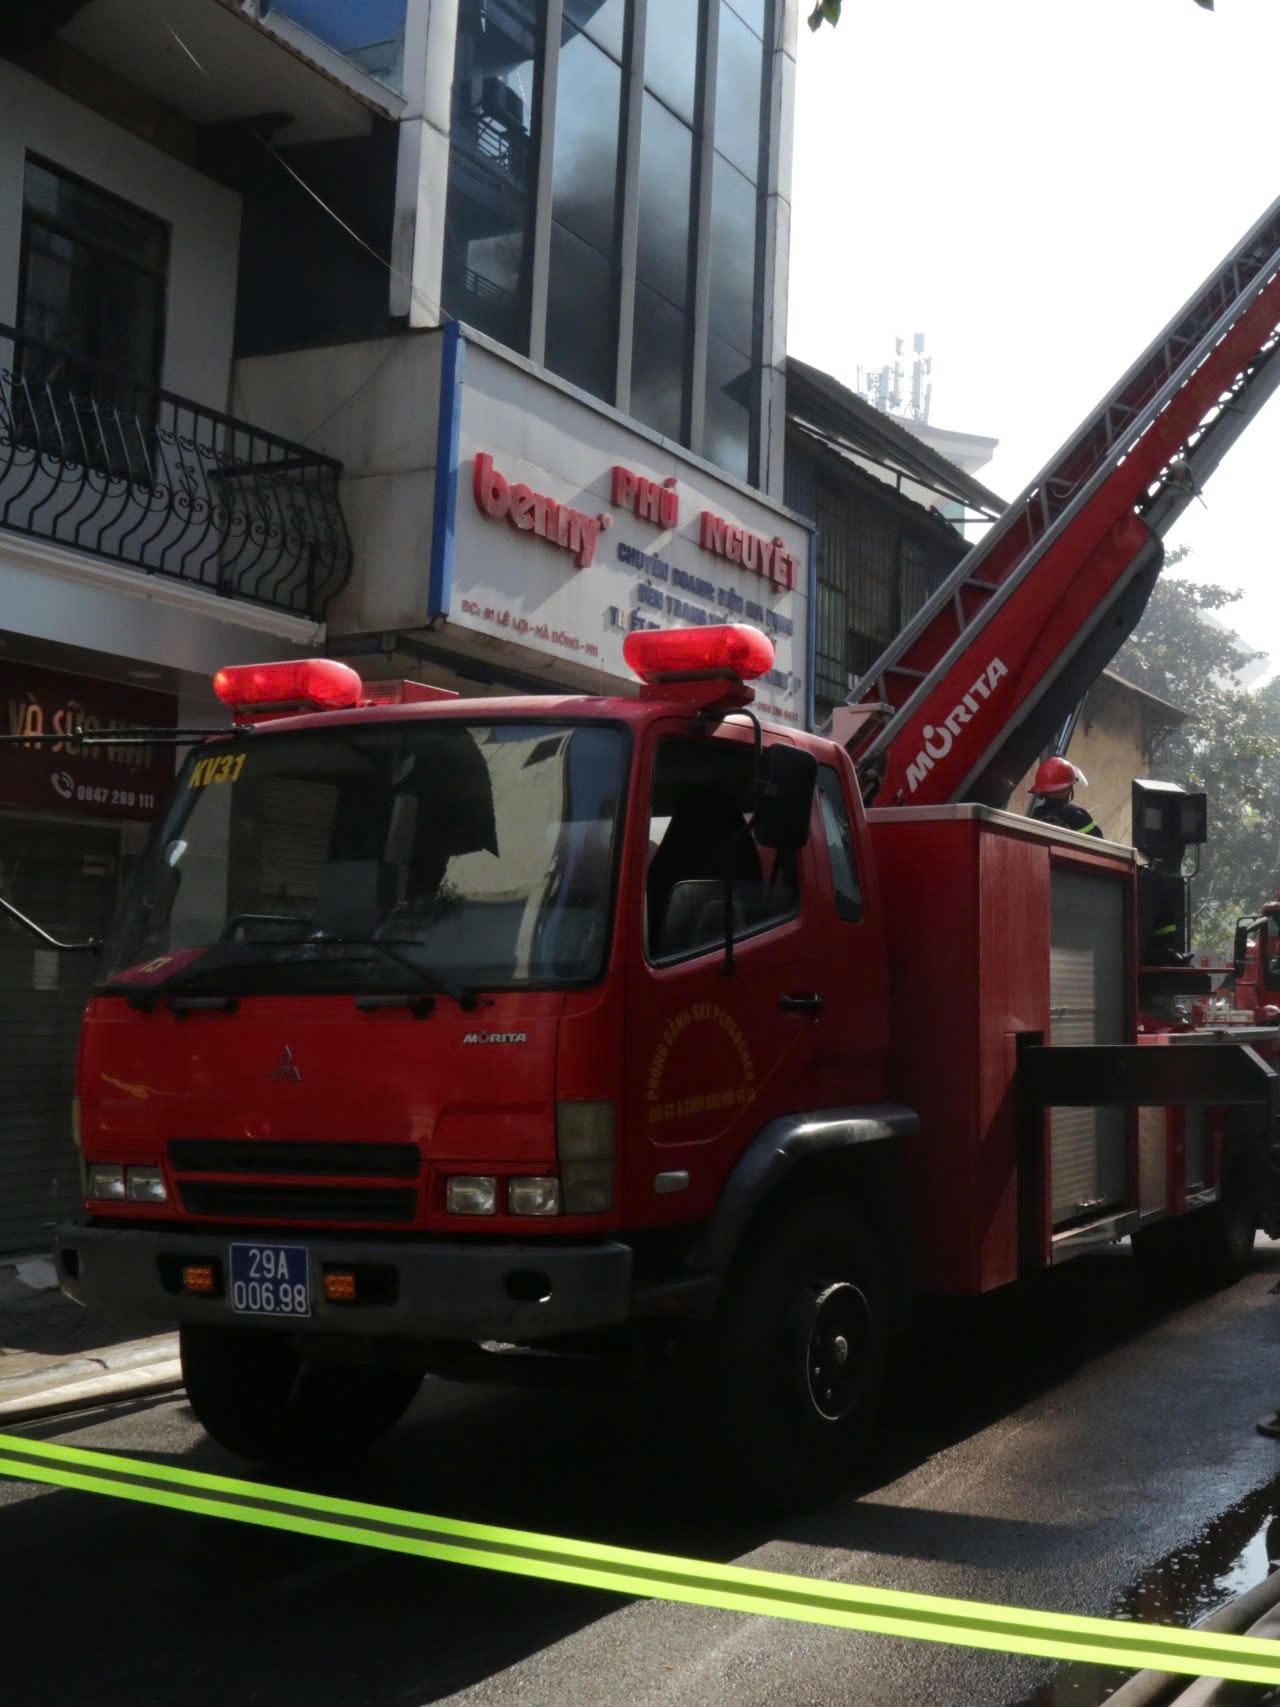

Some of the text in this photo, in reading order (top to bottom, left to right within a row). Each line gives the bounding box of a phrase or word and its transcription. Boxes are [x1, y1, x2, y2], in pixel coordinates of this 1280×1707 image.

[611, 465, 801, 593] PHÚ NGUYỆT
[905, 656, 1009, 793] MORITA
[188, 753, 246, 789] KV31
[463, 1032, 527, 1044] MORITA
[248, 1247, 289, 1280] 29A
[233, 1281, 307, 1313] 006.98
